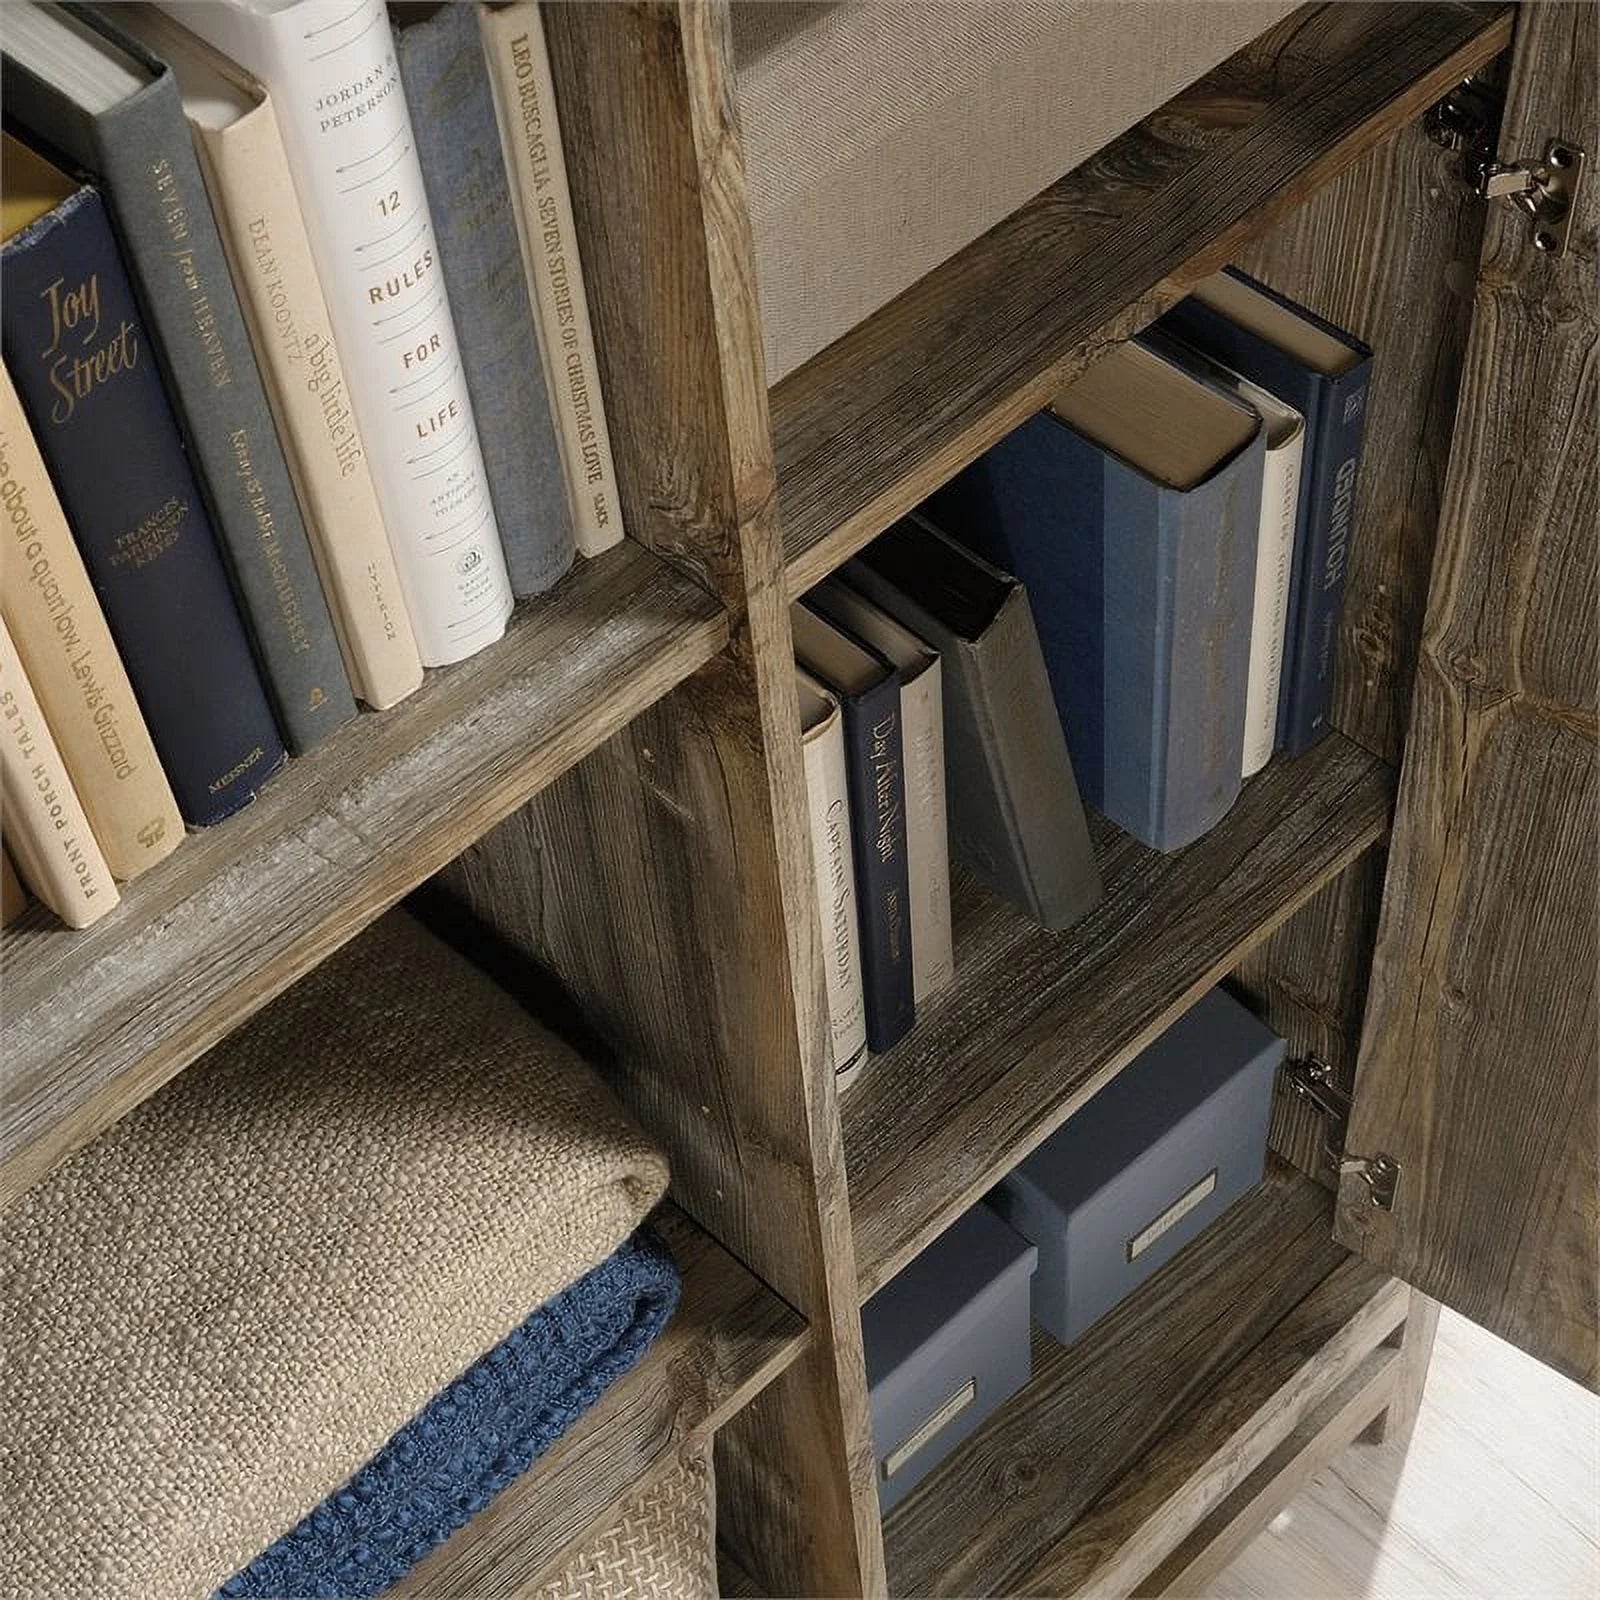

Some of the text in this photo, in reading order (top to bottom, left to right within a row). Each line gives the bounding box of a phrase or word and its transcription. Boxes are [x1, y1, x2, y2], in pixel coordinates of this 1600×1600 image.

[511, 33, 533, 79] LEO
[314, 64, 385, 112] JORDAN
[319, 72, 399, 133] PETERSON
[518, 80, 551, 192] BUSCAGLIA
[377, 190, 402, 217] 12
[538, 196, 562, 254] SEVEN
[249, 217, 305, 366] DEAN KOONTZ
[368, 250, 434, 305] RULES
[549, 256, 575, 327] STORIES
[40, 274, 99, 359] Joy
[561, 327, 579, 350] OF
[51, 321, 138, 425] Street
[403, 333, 441, 369] FOR
[304, 332, 363, 479] a big little life
[416, 400, 460, 438] LIFE
[566, 352, 596, 442] CHRISTMAS
[582, 444, 604, 485] LOVE
[1, 480, 39, 543] about
[1324, 458, 1355, 592] HOUNDED
[25, 541, 43, 561] a
[28, 558, 66, 613] quart
[70, 648, 105, 711] Lewis
[93, 702, 139, 781] Grizzard
[0, 691, 98, 899] FRONT PORCH TALES
